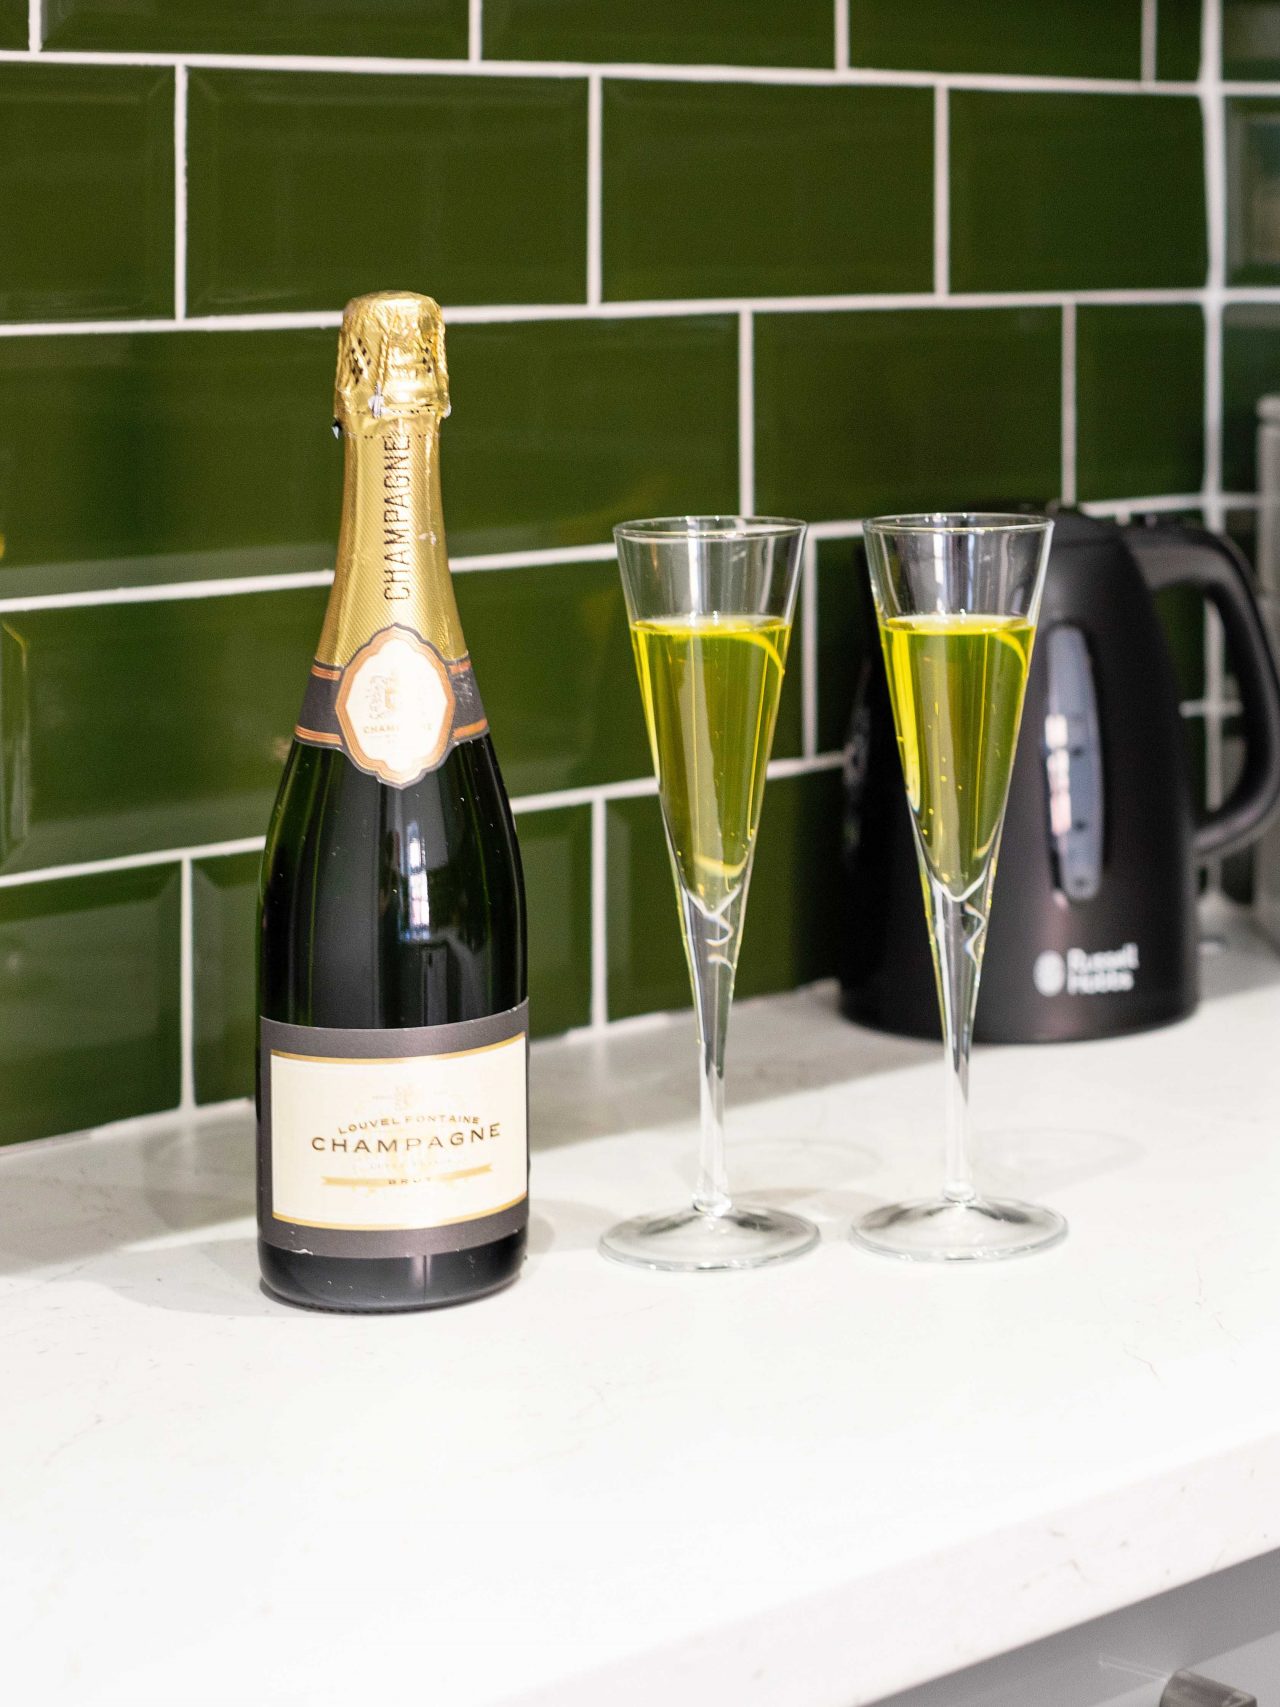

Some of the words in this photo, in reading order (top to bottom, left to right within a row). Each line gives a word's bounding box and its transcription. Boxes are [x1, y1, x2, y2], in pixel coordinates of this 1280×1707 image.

[383, 434, 411, 602] CHAMPAGNE
[311, 1122, 502, 1154] CHAMPAGNE
[338, 1117, 400, 1135] LOUVEL
[404, 1114, 481, 1126] FONTAINE
